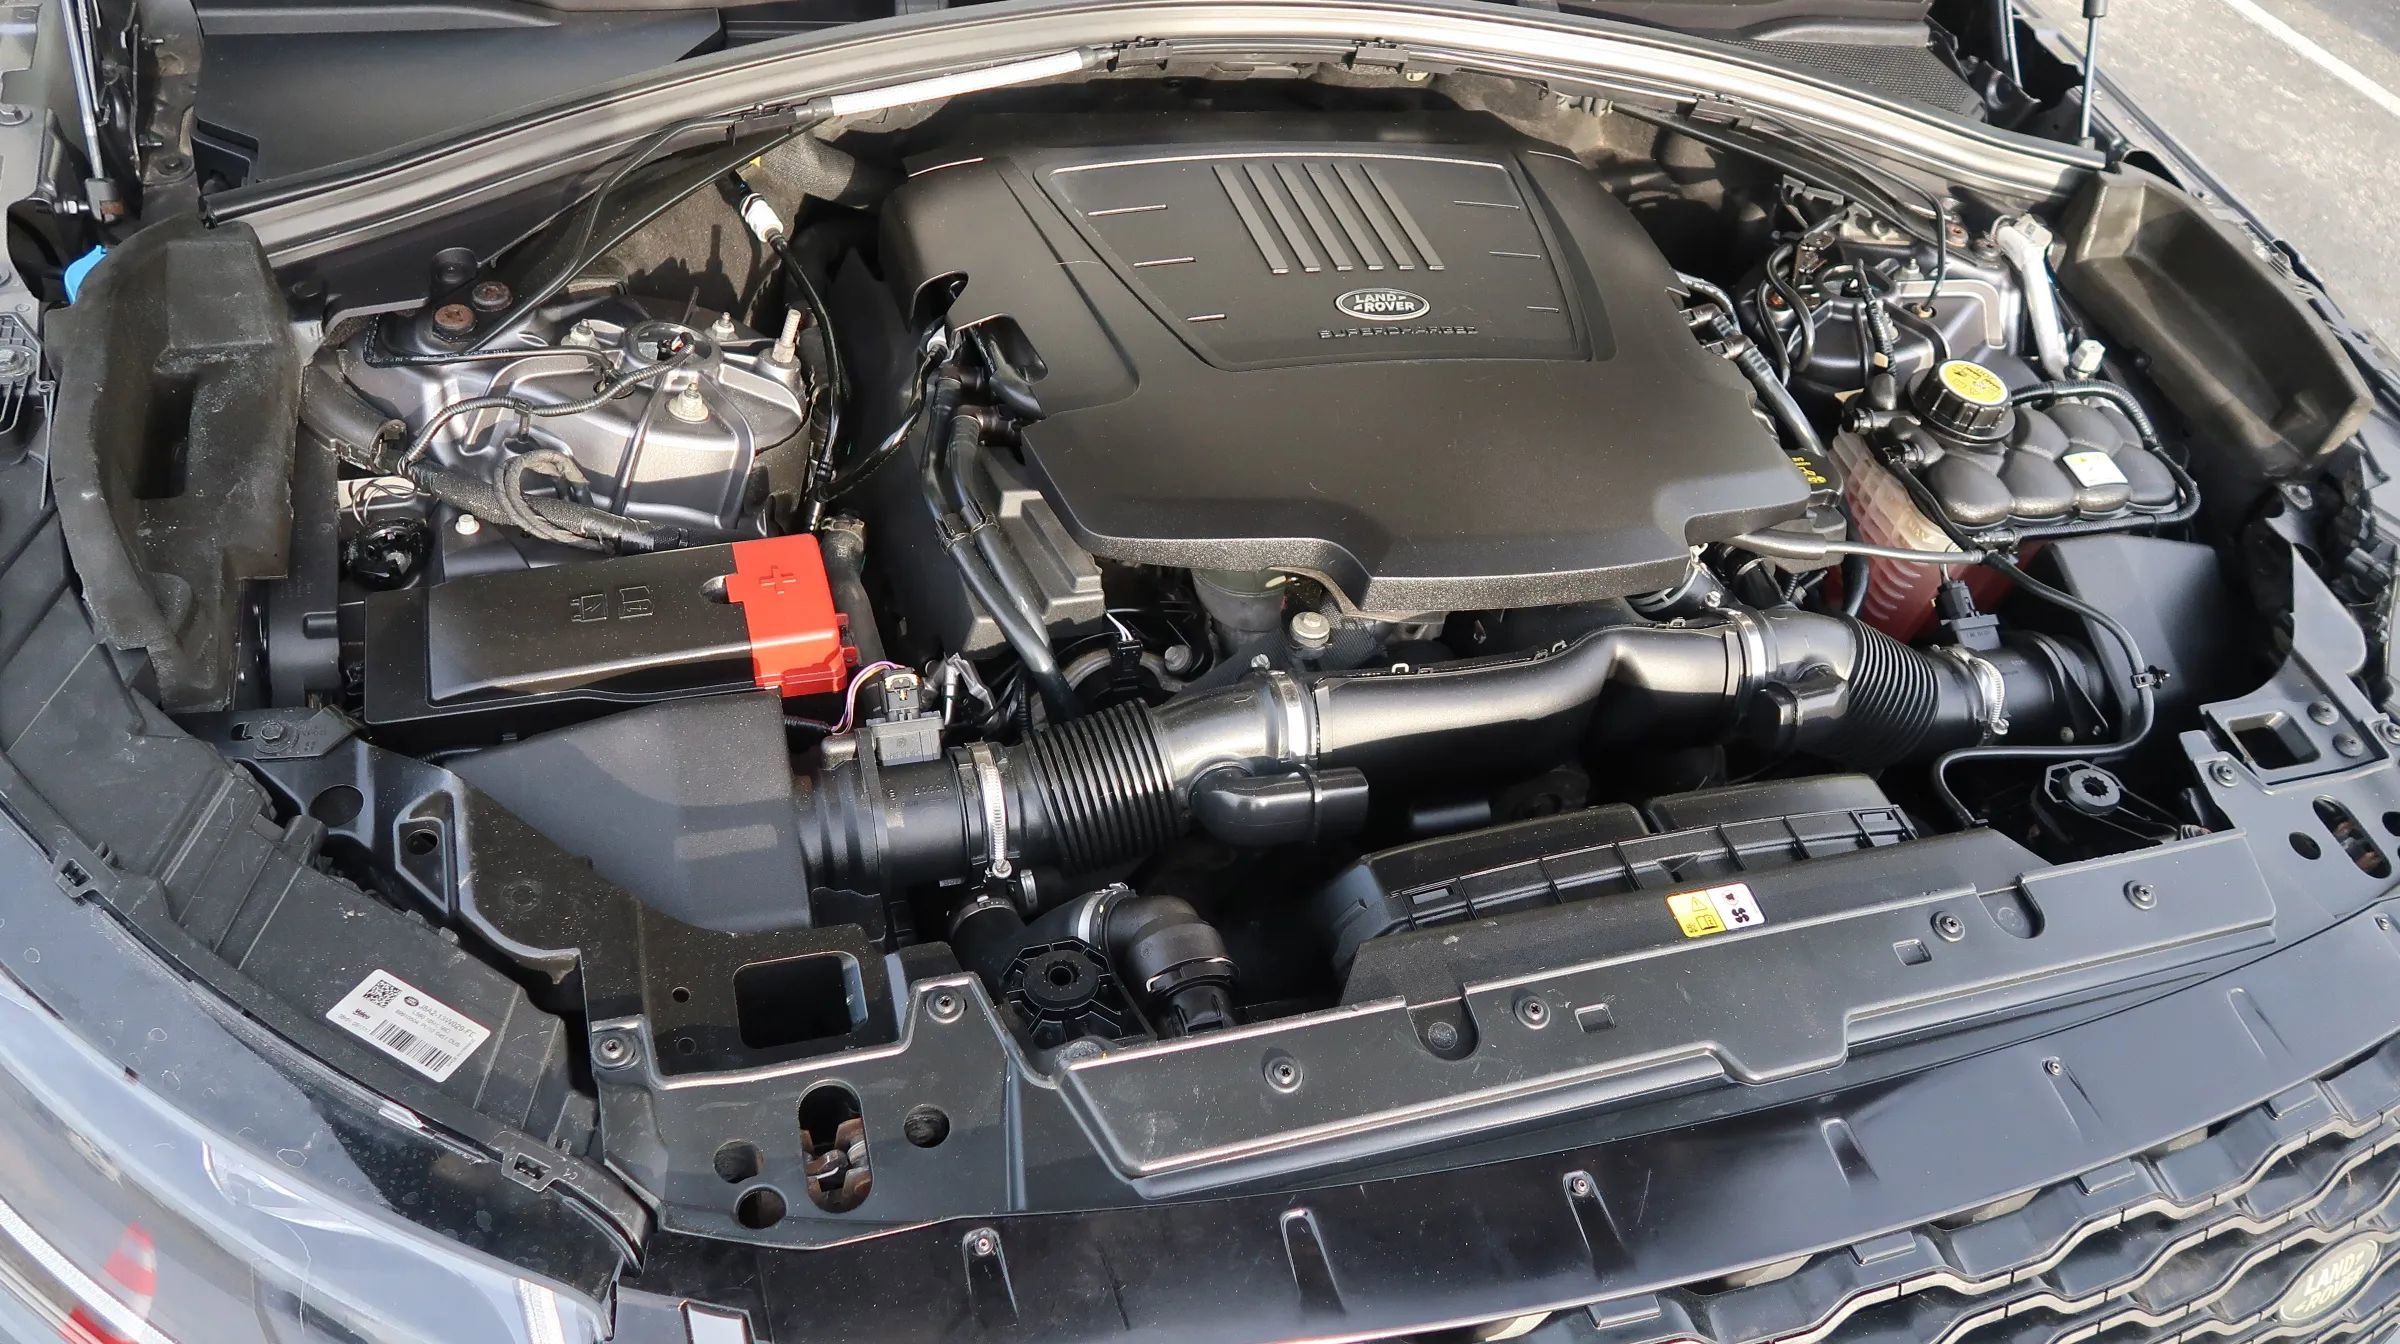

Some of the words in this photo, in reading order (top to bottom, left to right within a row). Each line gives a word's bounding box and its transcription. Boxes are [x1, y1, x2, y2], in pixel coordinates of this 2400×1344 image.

[1354, 293, 1397, 303] LAND
[1364, 301, 1415, 313] ROVER
[2303, 1252, 2356, 1297] LAND
[2303, 1263, 2366, 1314] ROVER
